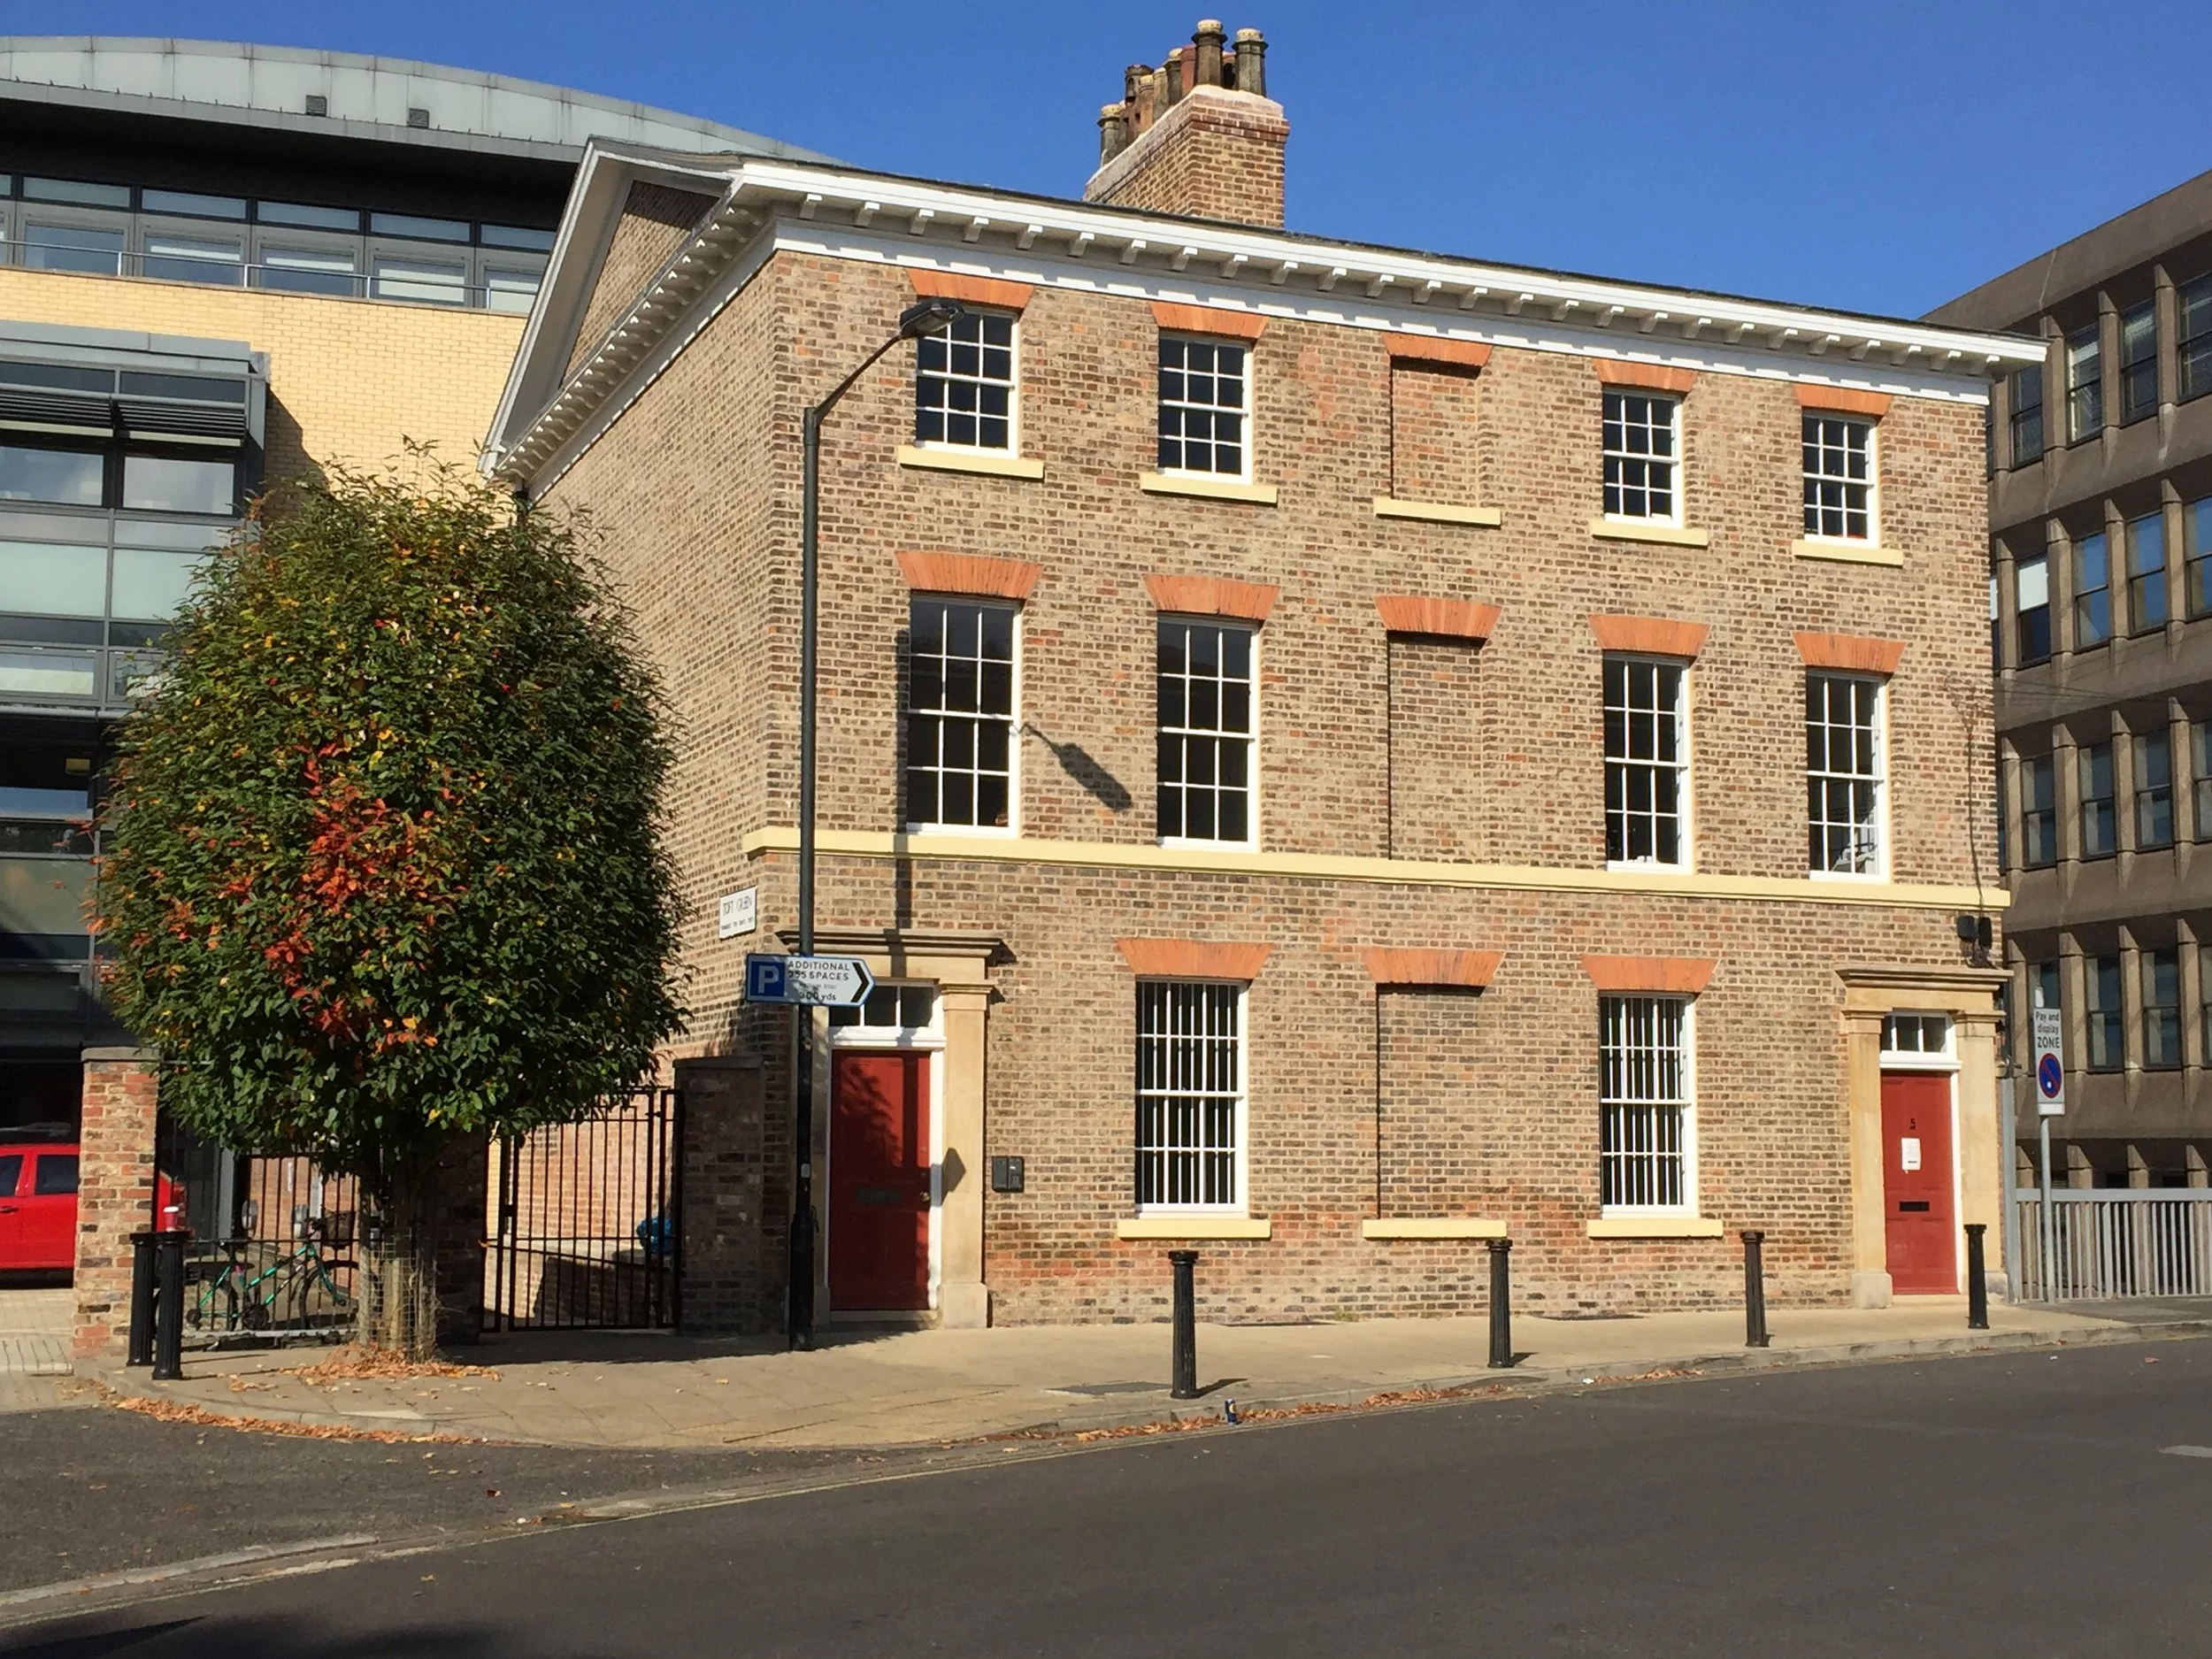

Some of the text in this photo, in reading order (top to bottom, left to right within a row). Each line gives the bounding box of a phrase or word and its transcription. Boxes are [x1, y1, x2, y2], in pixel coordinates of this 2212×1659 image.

[787, 960, 849, 972] ADDITIONAL
[757, 964, 780, 994] P
[809, 971, 849, 981] SPACES
[821, 992, 836, 1002] yds
[2035, 1010, 2047, 1023] Pay
[2037, 1024, 2059, 1035] display
[2037, 1036, 2061, 1048] ZONE
